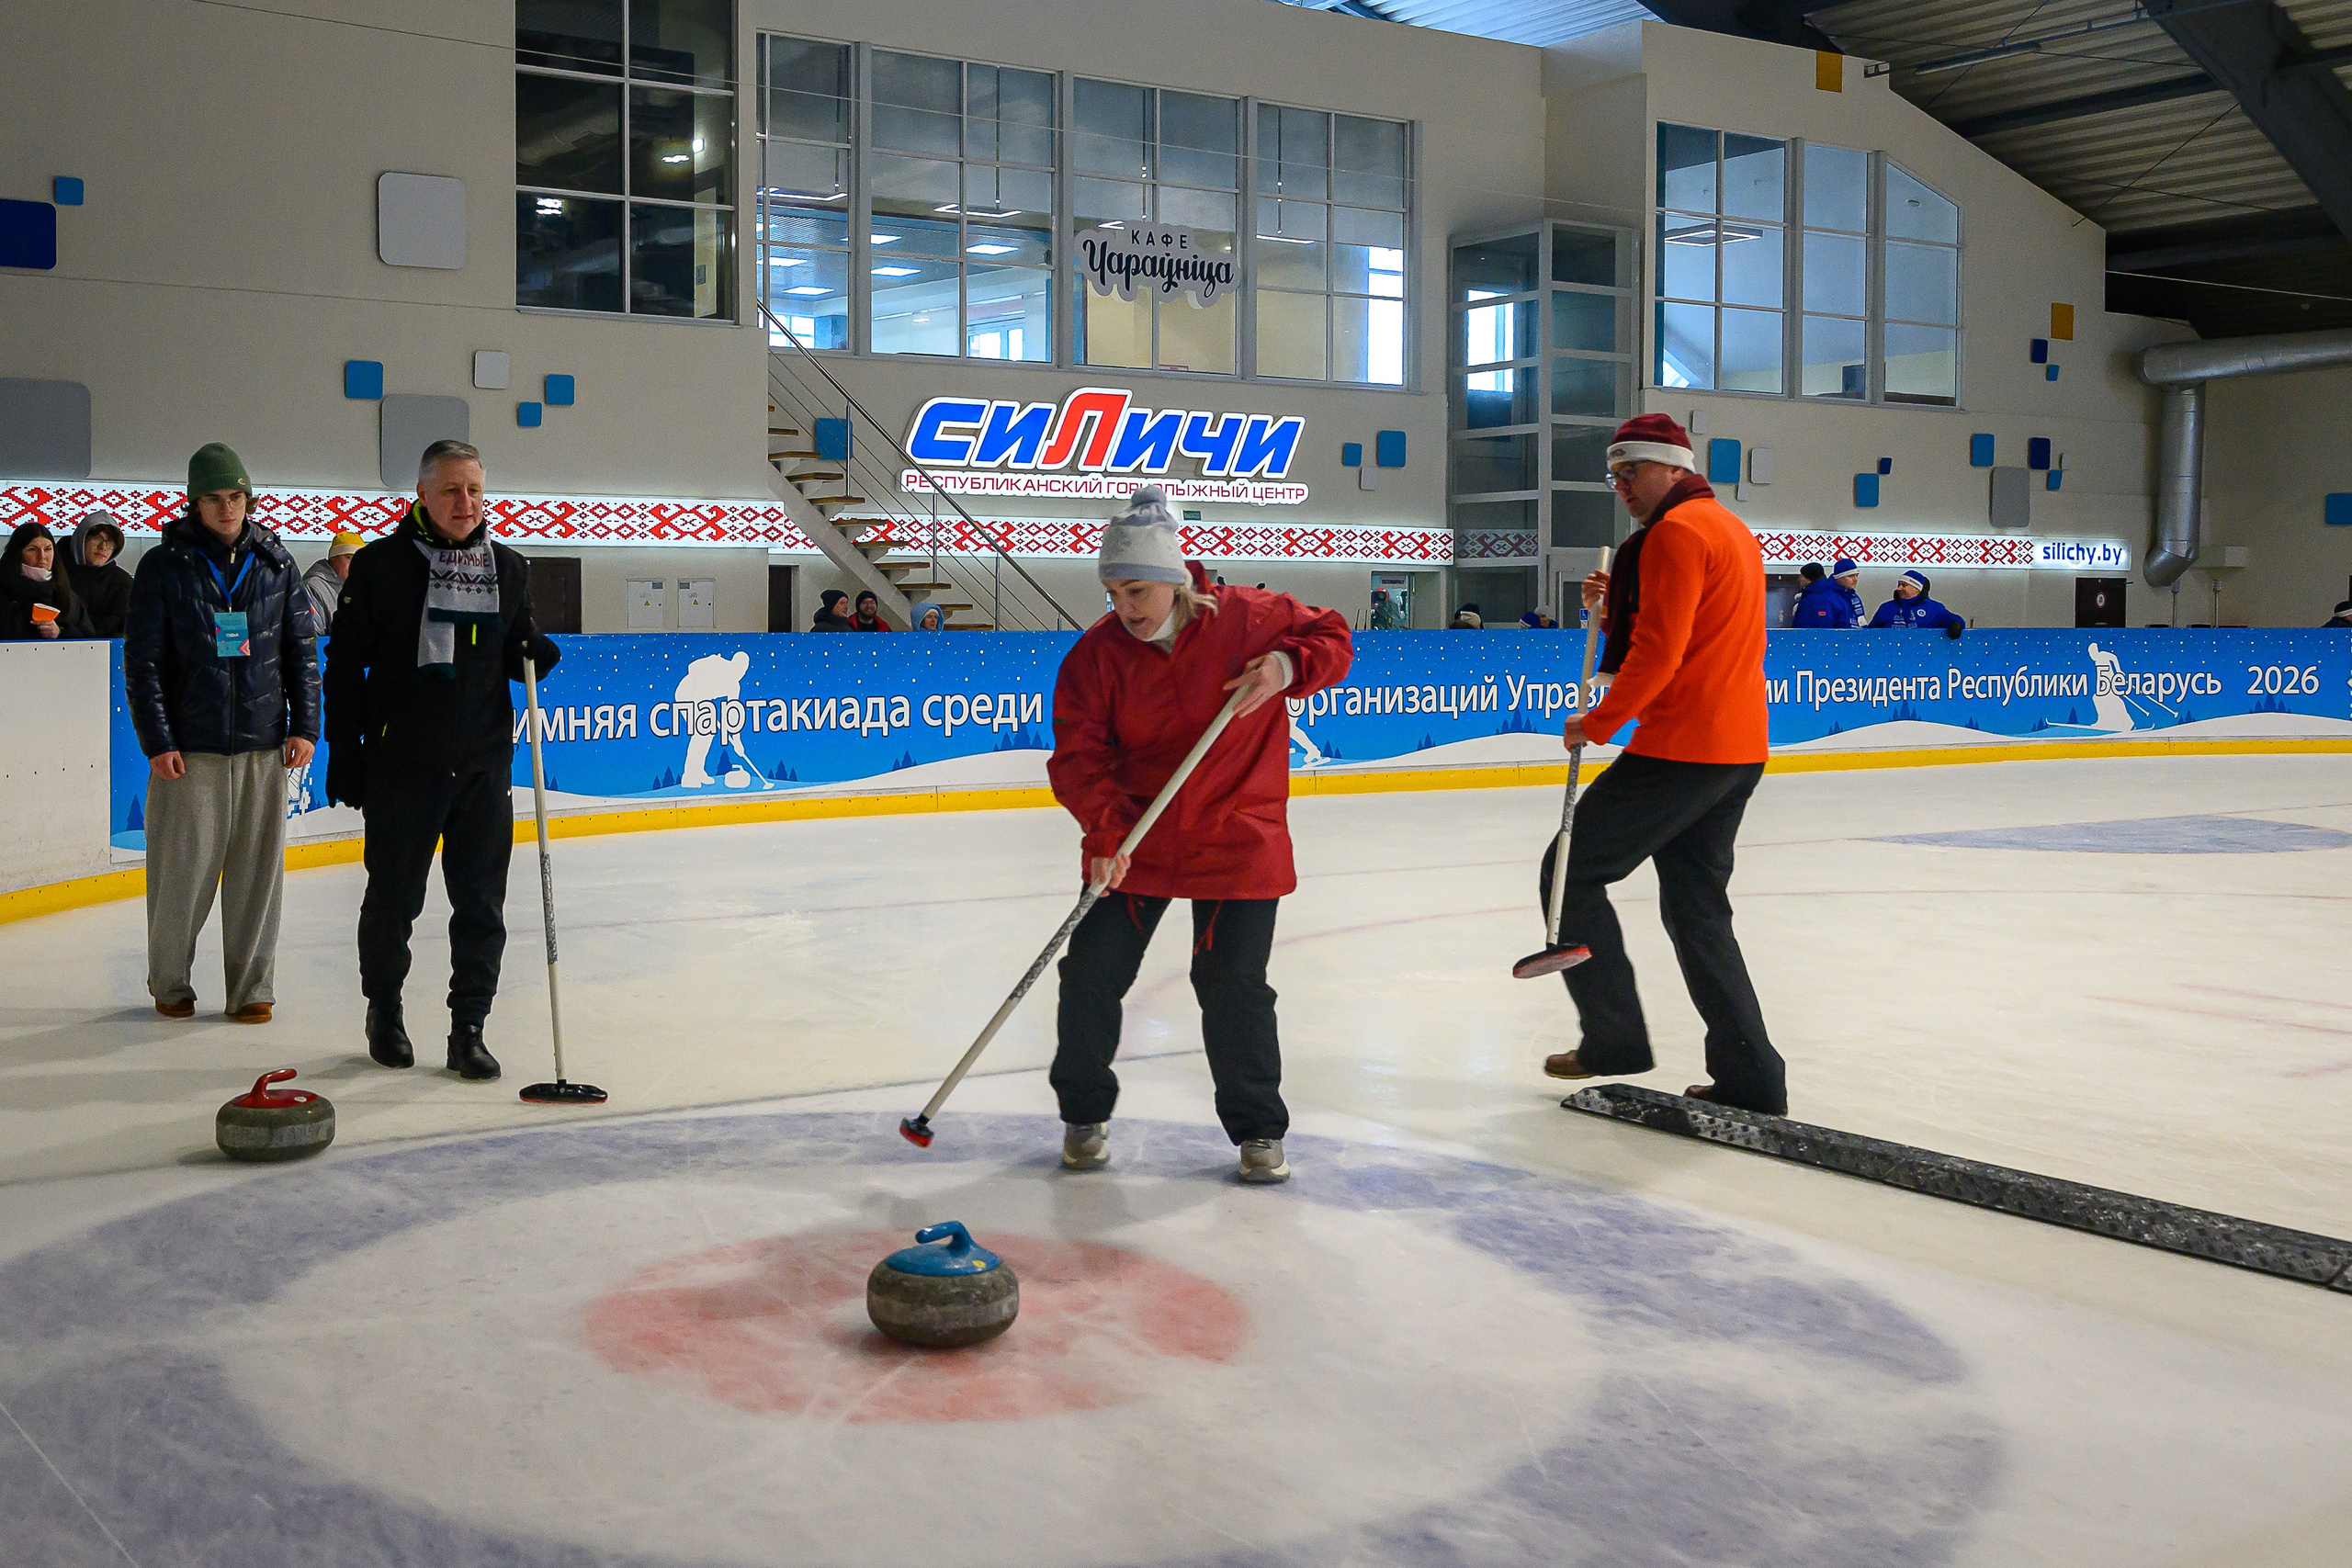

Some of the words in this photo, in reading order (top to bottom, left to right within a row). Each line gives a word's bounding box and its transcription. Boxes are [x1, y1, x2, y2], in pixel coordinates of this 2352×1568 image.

[1131, 229, 1189, 250] КАФЕ
[1082, 239, 1235, 299] Чараўніца
[906, 474, 1102, 493] РЕСПУБЛИКАНСКИЙ
[1107, 480, 1249, 498] ГОРЛЫЖНЫЙ
[1253, 486, 1306, 501] ЦЕНТР
[2042, 542, 2123, 566] silichy.by
[513, 703, 638, 743] имняя
[649, 694, 910, 745] спартакиада
[922, 691, 1043, 736] среди
[1285, 674, 1498, 727] организаций
[1796, 670, 1941, 712] Президента
[1948, 666, 2088, 707] Республики
[2095, 664, 2222, 710] Беларусь
[2246, 663, 2320, 697] 2026
